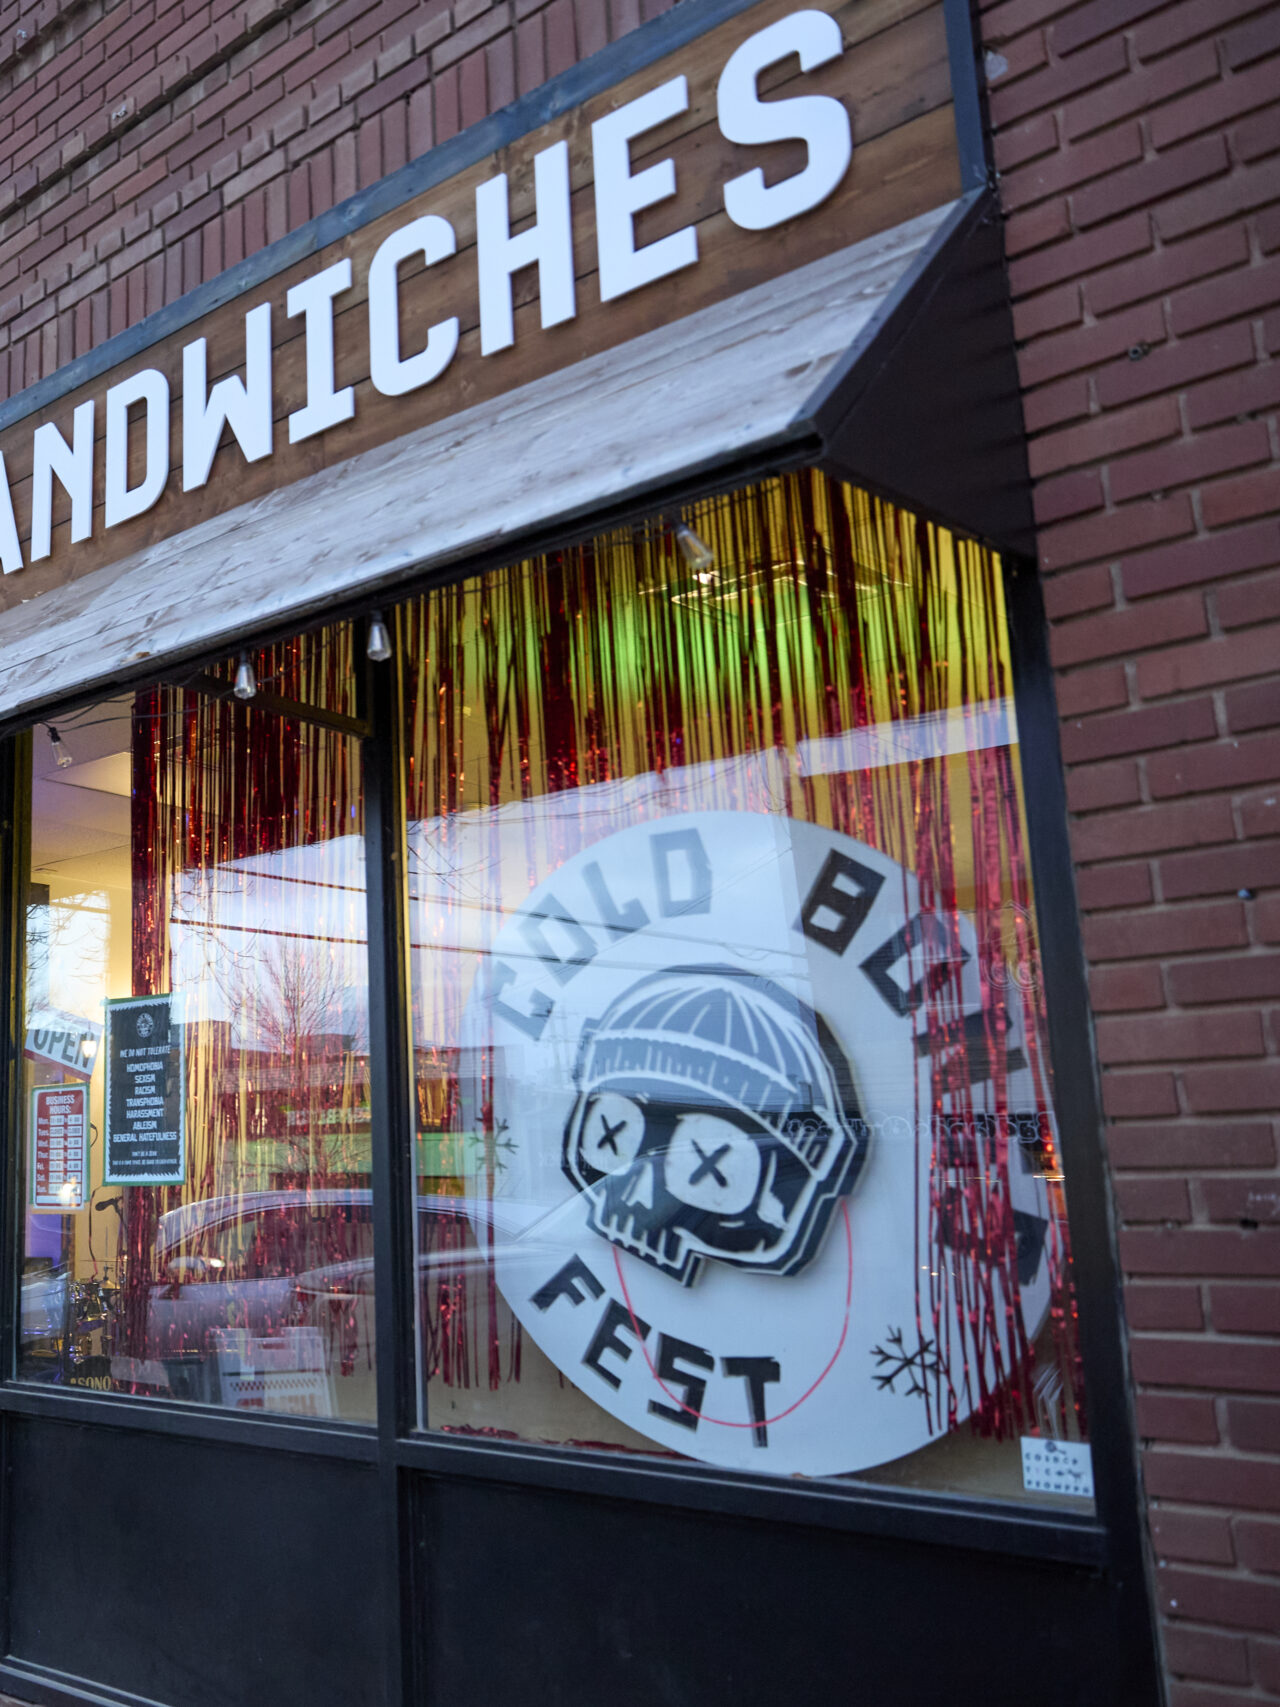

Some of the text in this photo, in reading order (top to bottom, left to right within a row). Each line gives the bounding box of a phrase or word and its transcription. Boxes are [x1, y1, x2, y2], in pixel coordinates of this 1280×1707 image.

[481, 828, 712, 1042] COLD
[34, 1027, 94, 1068] OPEN
[126, 1061, 164, 1072] HOMOPHOBIA
[134, 1074, 156, 1083] SEXISM
[134, 1085, 156, 1095] RACISM
[46, 1095, 75, 1105] BUSINESS
[126, 1096, 164, 1107] TRANSPHOBIA
[49, 1104, 72, 1114] HOURS:
[126, 1108, 164, 1119] HARASSMENT
[132, 1120, 157, 1130] ABLEISM
[113, 1131, 177, 1143] GENERAL HATEFULNESS
[529, 1255, 781, 1447] FEST
